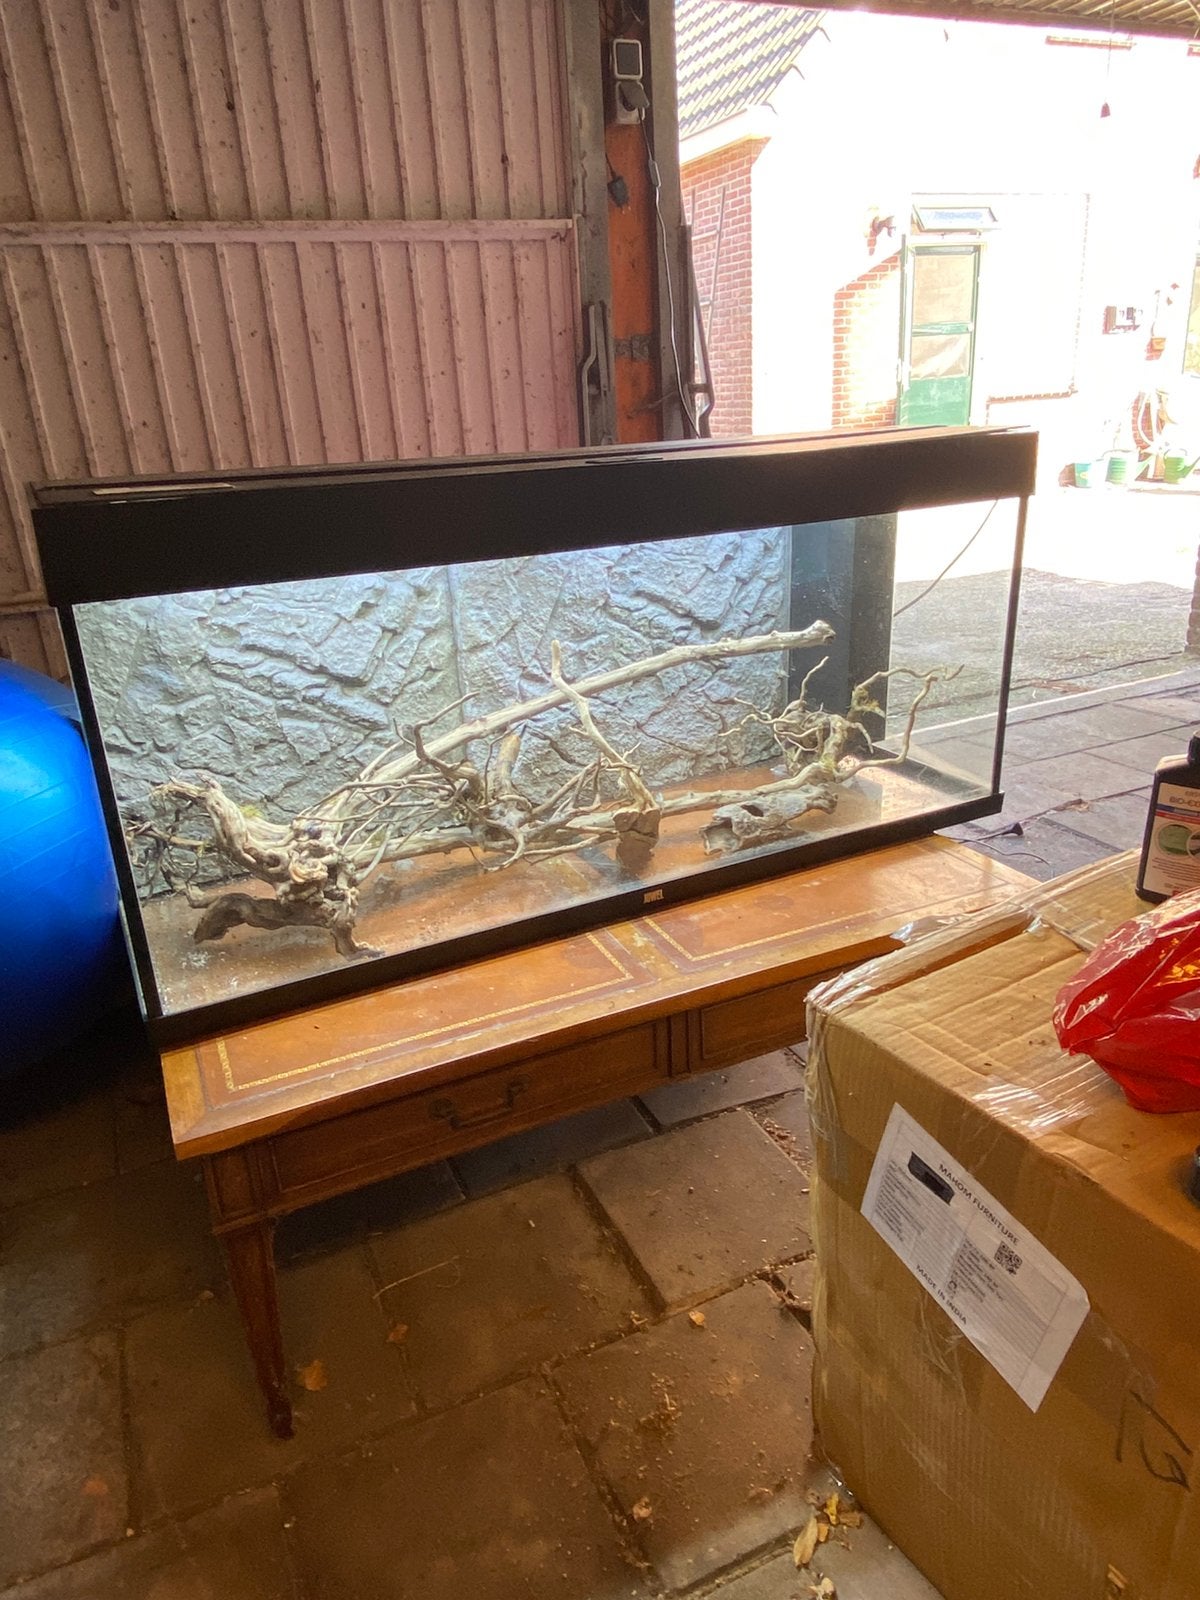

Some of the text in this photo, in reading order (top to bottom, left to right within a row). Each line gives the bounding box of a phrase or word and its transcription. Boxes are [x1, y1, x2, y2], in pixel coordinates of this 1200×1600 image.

[973, 1198, 1019, 1246] FURNITURE
[916, 1264, 936, 1289] MADE
[946, 1299, 967, 1325] INDIA
